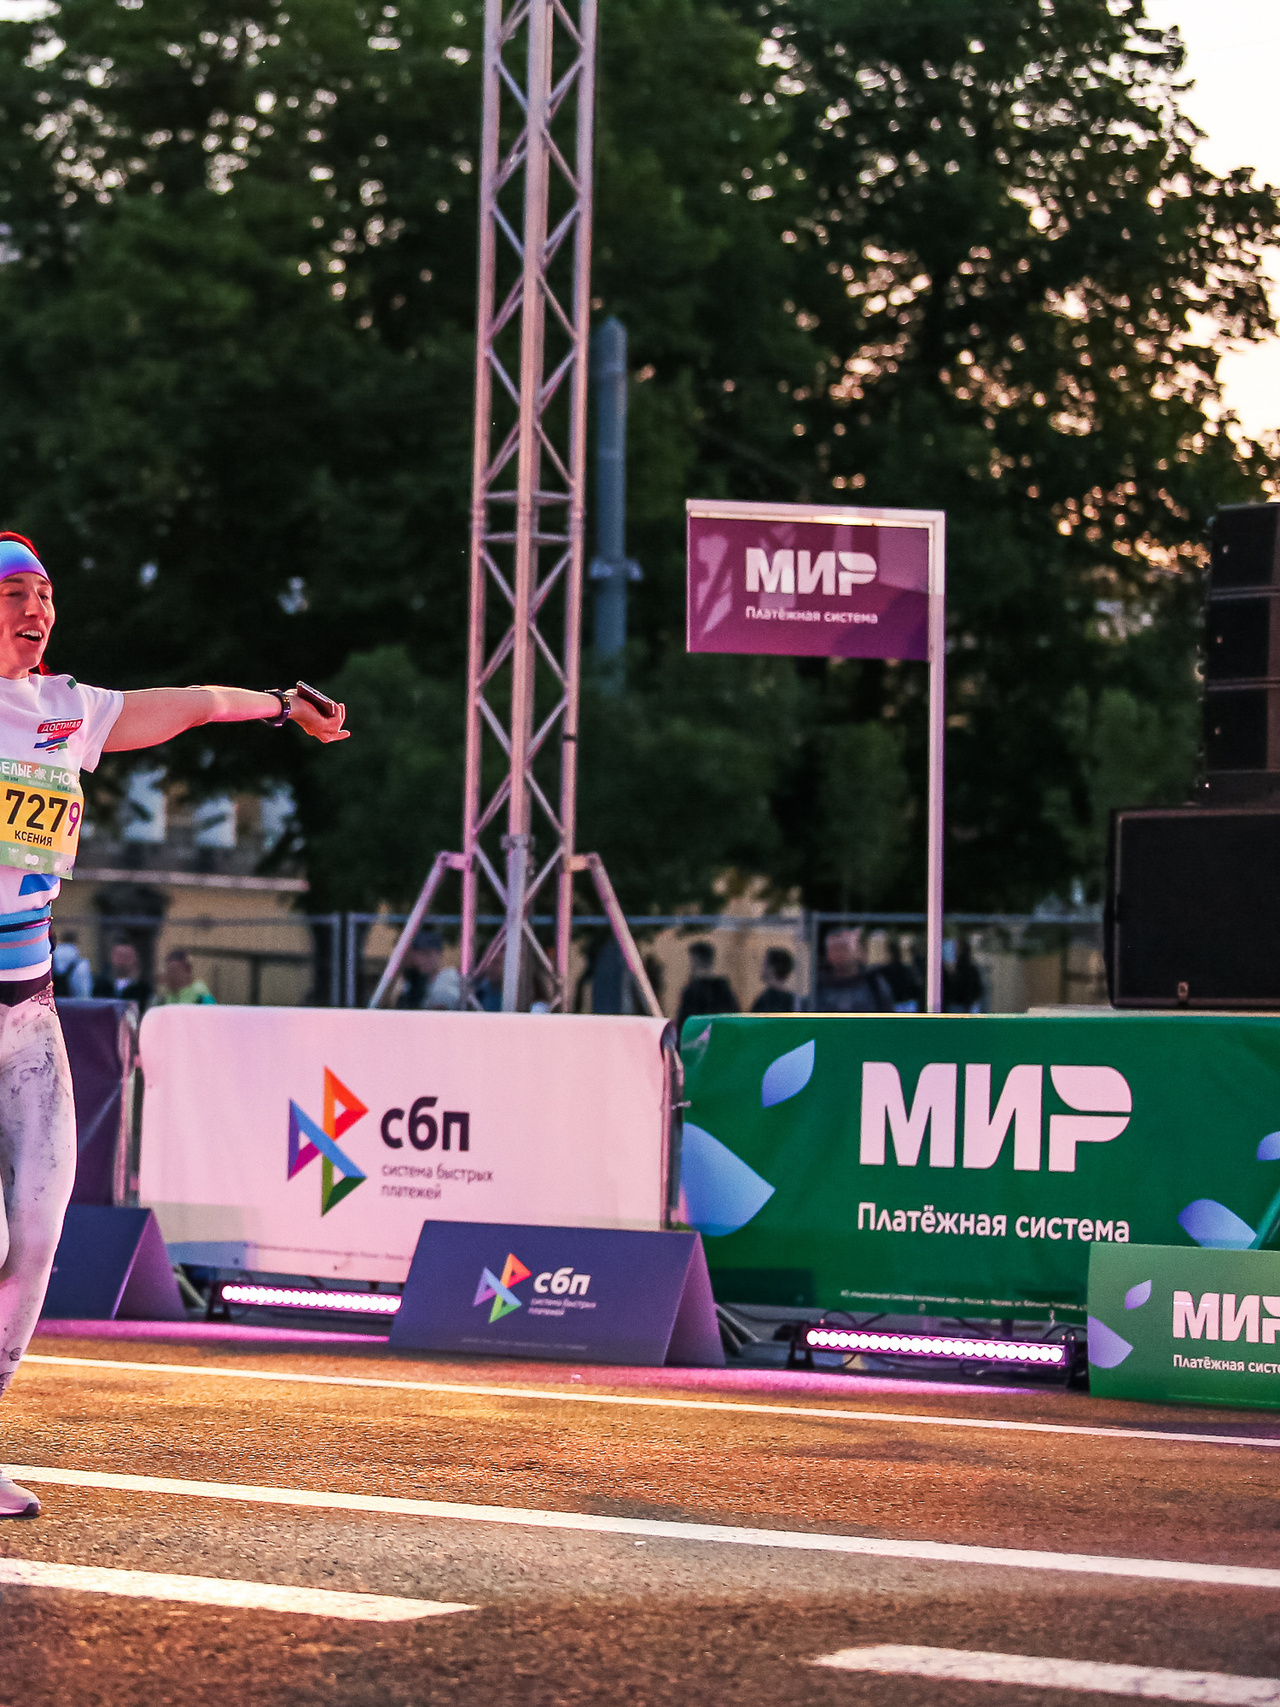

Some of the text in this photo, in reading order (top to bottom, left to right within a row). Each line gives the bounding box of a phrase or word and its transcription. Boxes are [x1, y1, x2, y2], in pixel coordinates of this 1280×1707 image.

[745, 547, 877, 596] МИР
[745, 605, 878, 625] Платёжная система
[14, 830, 53, 846] КСЕНИЯ
[859, 1061, 1132, 1173] МИР
[858, 1201, 1131, 1243] Платёжная система
[1173, 1354, 1245, 1372] Платёжная
